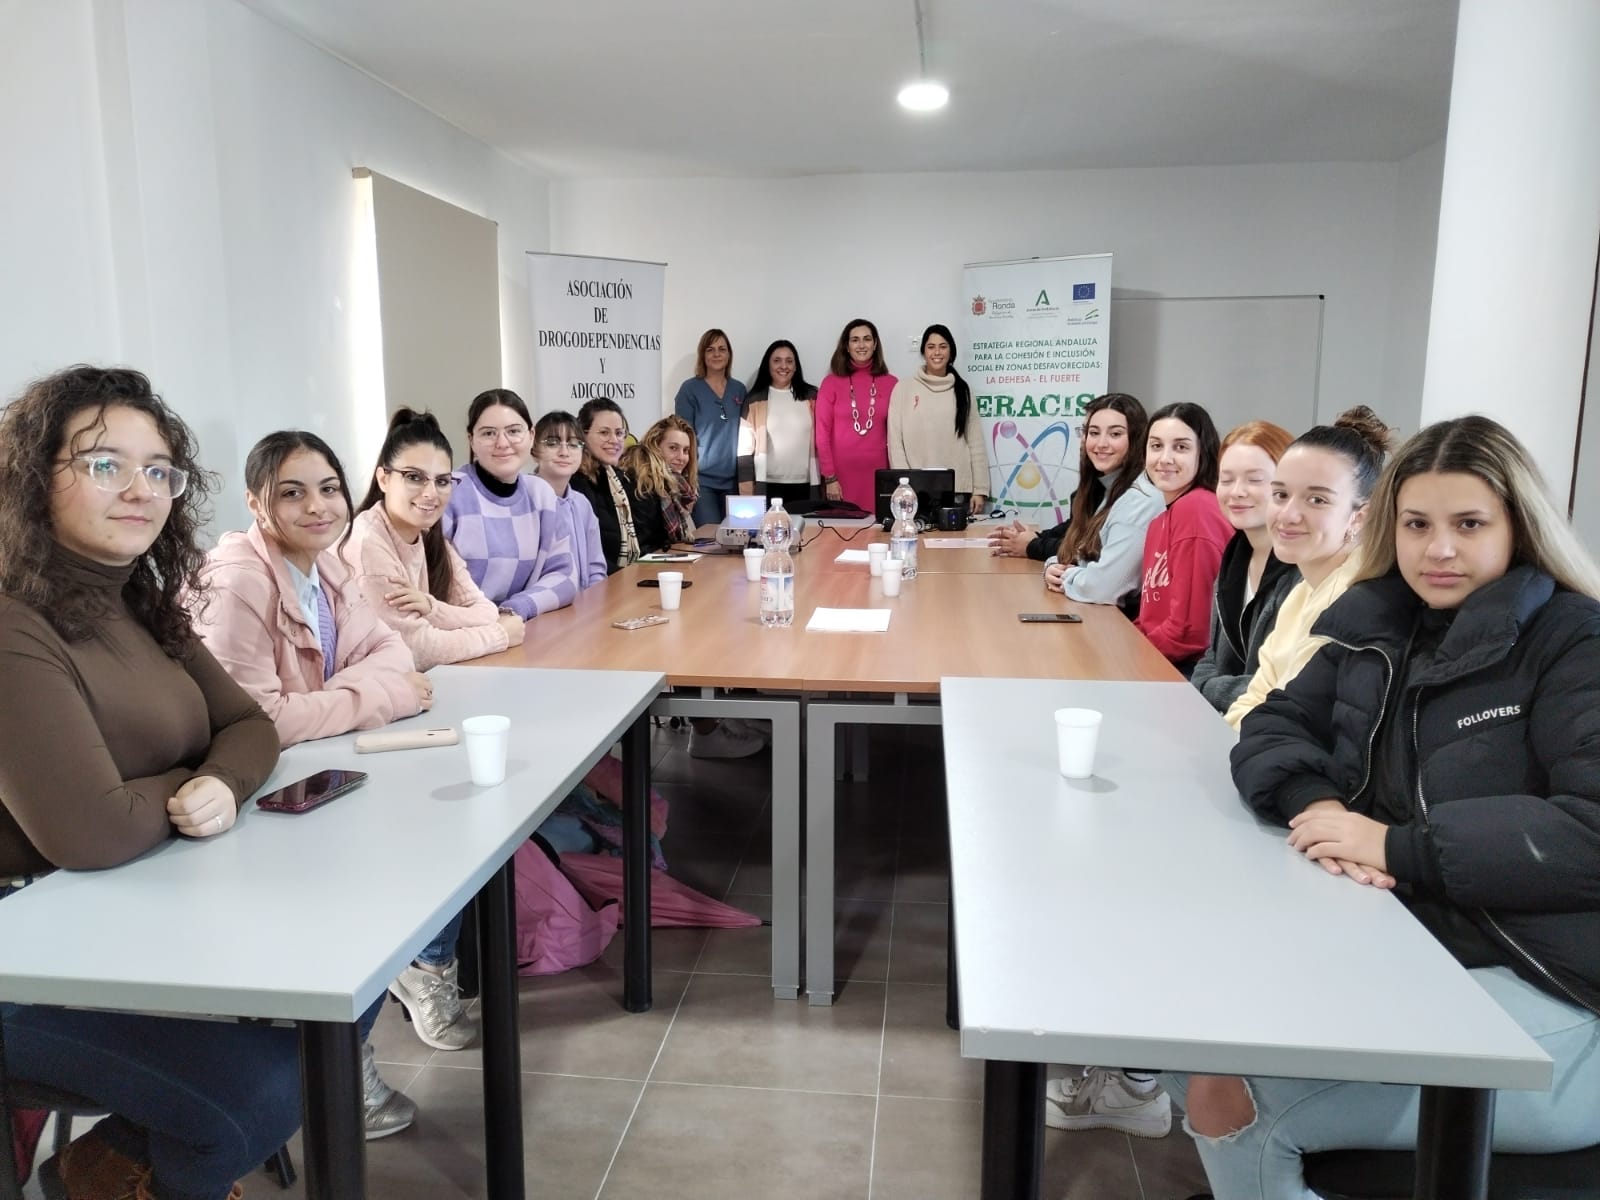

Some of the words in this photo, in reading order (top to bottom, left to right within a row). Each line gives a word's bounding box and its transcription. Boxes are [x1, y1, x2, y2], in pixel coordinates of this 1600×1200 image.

[566, 278, 633, 300] ASOCIACIÓN
[992, 302, 1016, 310] Ronda
[593, 307, 609, 324] DE
[538, 330, 661, 351] DROGODEPENDENCIAS
[972, 341, 1013, 350] ESTRATEGIA
[1015, 339, 1053, 348] REGIONAL
[1055, 338, 1098, 346] ANDALUZA
[974, 353, 993, 361] PARA
[1005, 350, 1045, 360] COHESIÓN
[1052, 348, 1096, 358] INCLUSIÓN
[600, 357, 606, 374] Y
[967, 365, 994, 373] SOCIAL
[1006, 363, 1033, 371] ZONAS
[986, 376, 997, 385] LA
[998, 375, 1031, 384] DEHESA
[1039, 375, 1048, 383] EL
[1050, 374, 1081, 383] FUERTE
[570, 382, 635, 400] ADICCIONES
[976, 393, 1096, 418] ERACIS
[1457, 705, 1521, 729] FOLLOVERS
